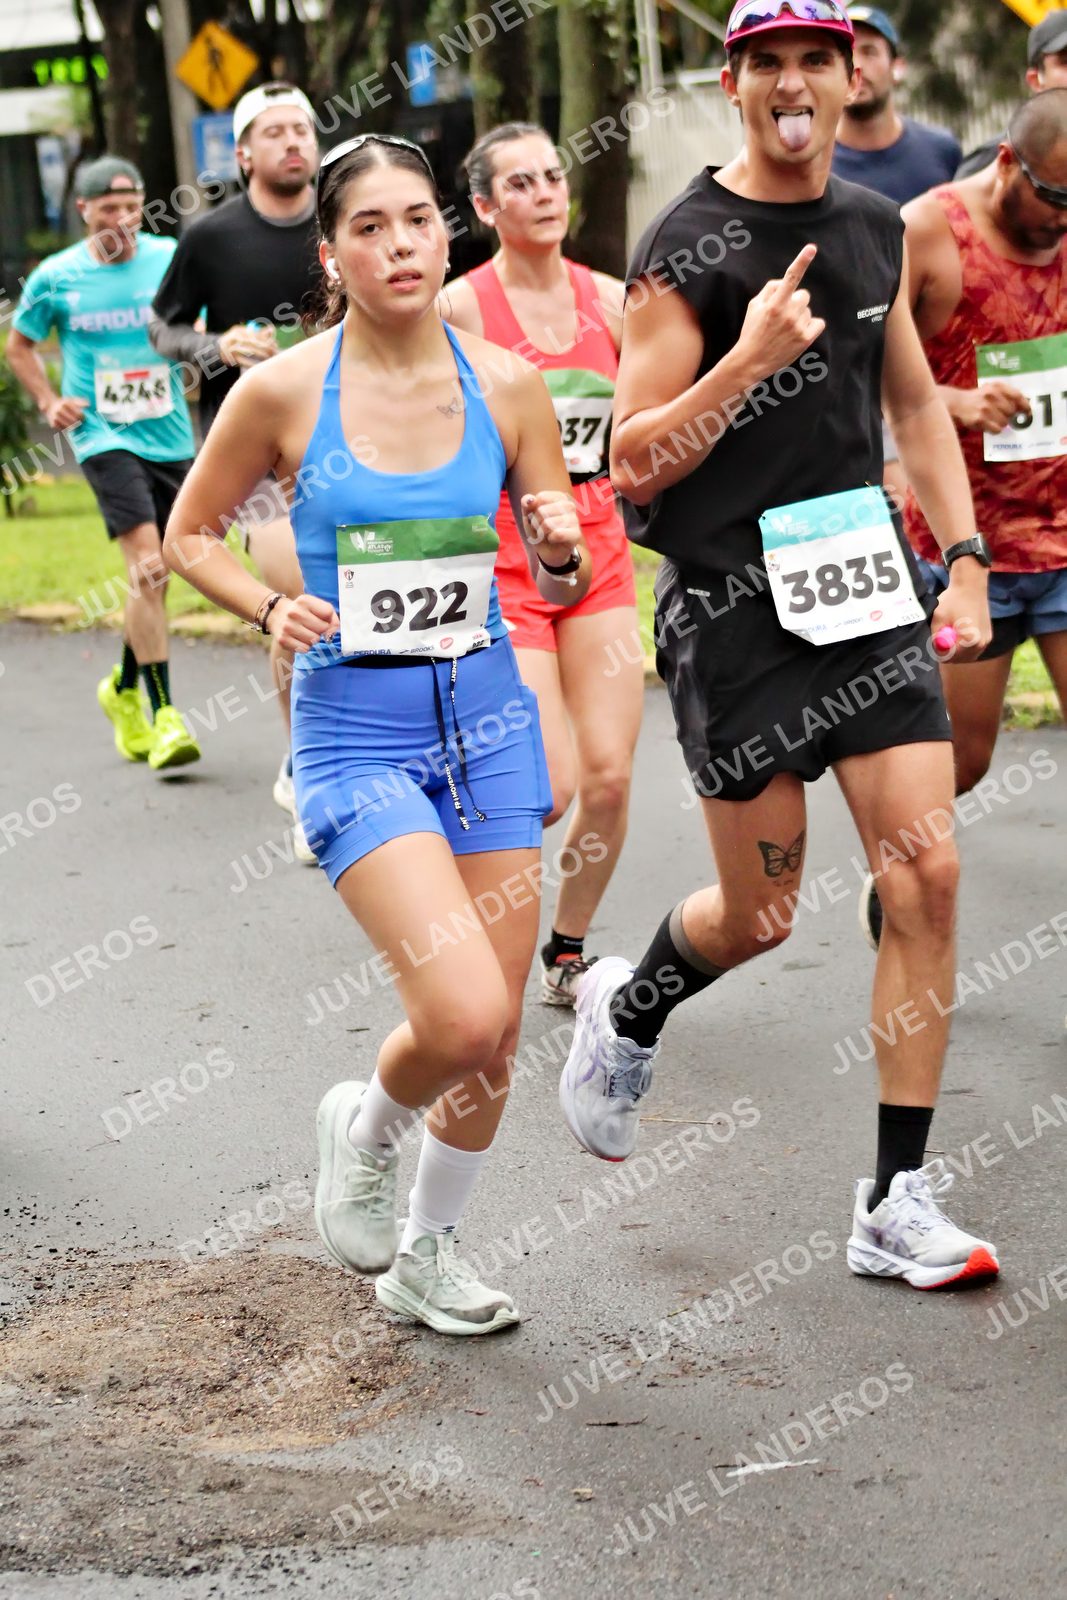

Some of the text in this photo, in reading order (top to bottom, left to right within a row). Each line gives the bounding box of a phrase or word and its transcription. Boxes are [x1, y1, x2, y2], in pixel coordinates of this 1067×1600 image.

[557, 417, 602, 446] 37
[370, 580, 469, 634] 922
[781, 550, 901, 614] 3835
